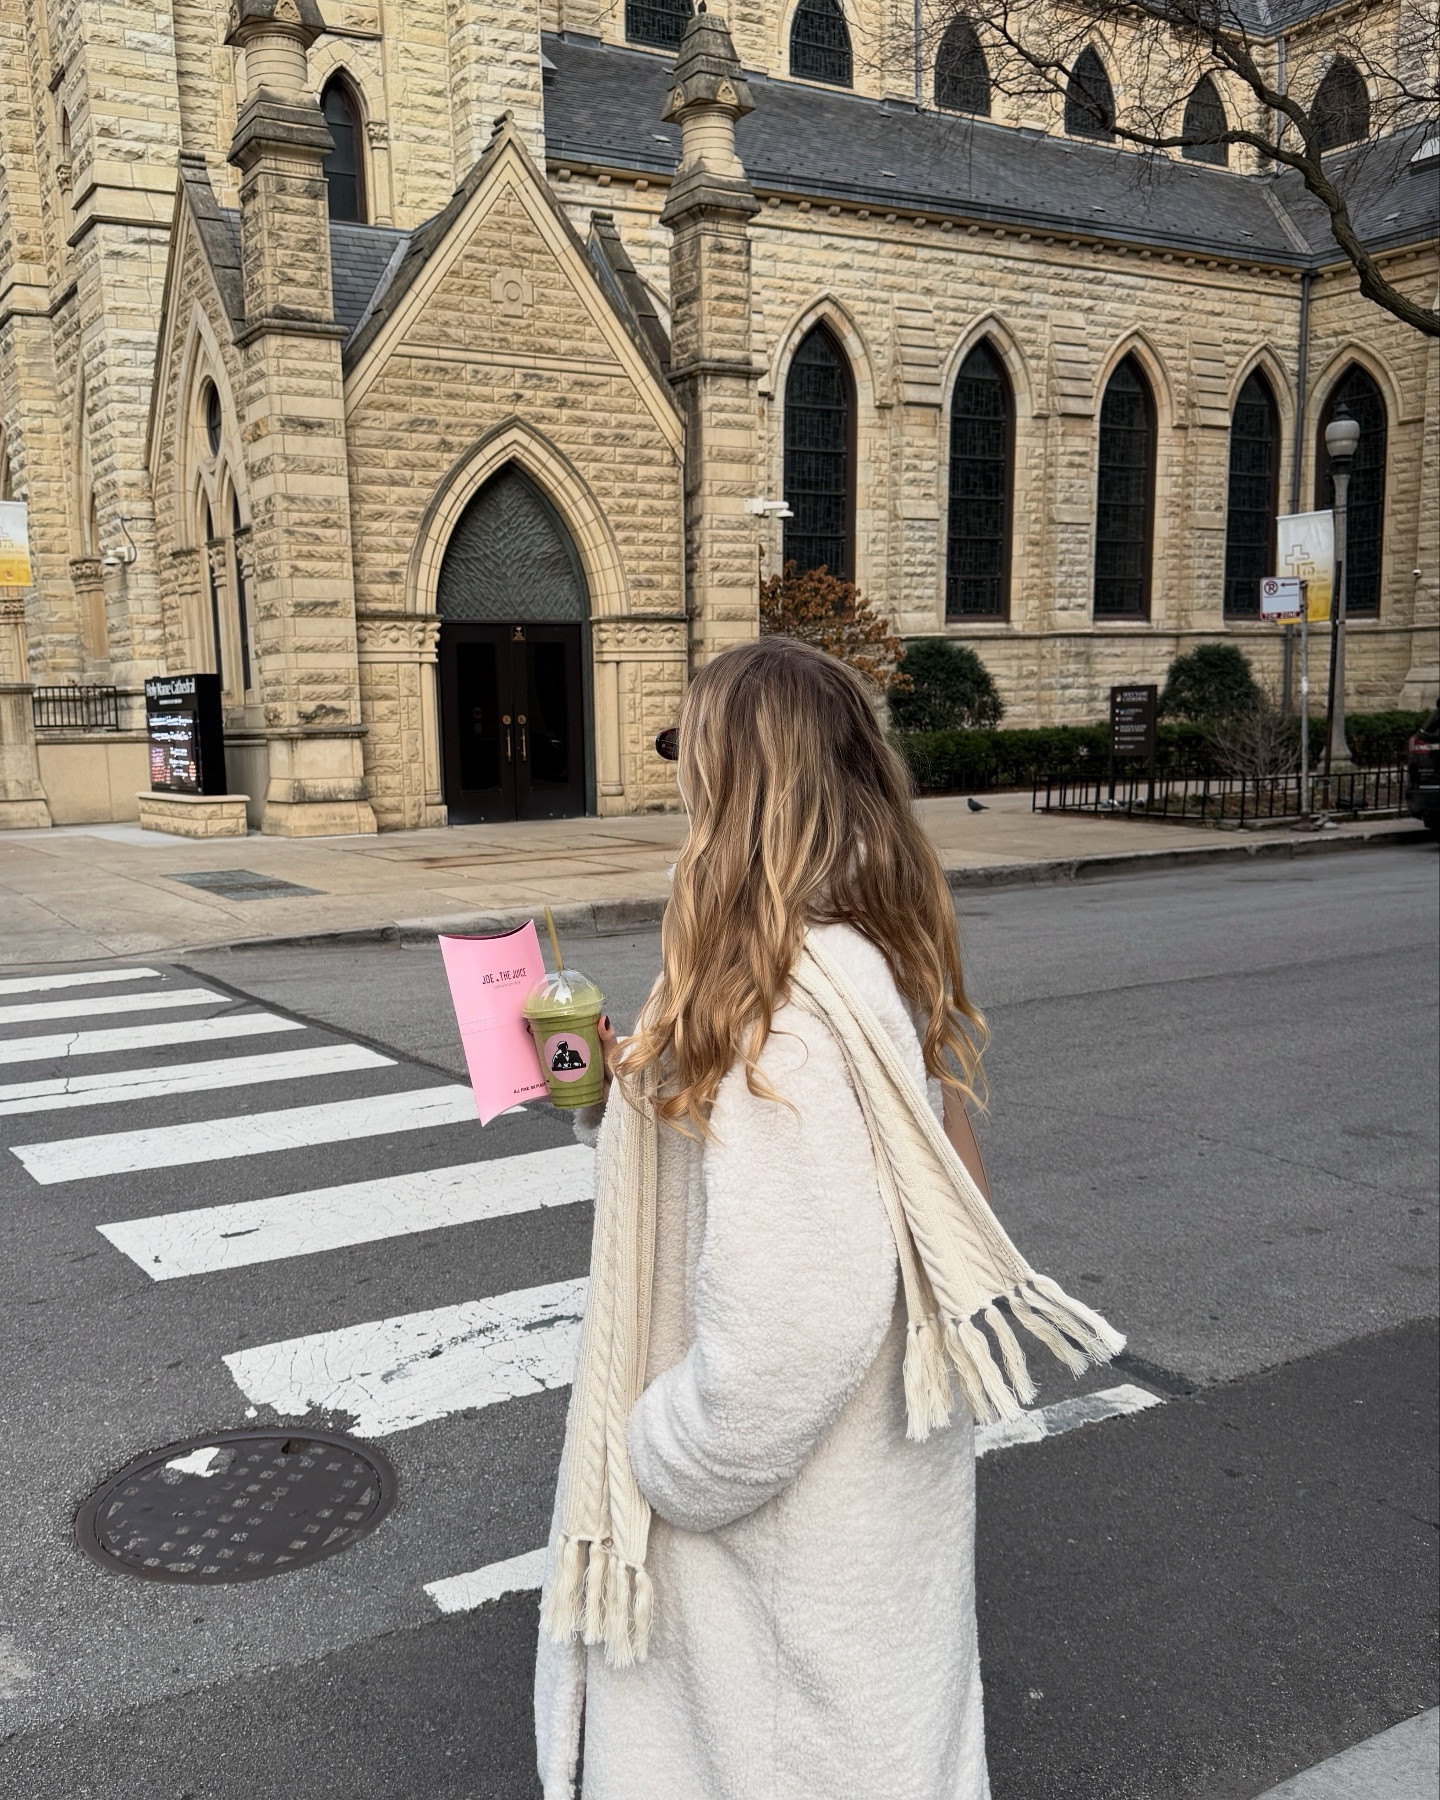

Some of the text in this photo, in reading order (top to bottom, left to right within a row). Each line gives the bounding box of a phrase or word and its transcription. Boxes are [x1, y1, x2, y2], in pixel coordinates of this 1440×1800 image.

[146, 678, 195, 700] Holy Name Cathedral
[482, 974, 494, 985] JOE
[499, 970, 512, 981] THE
[512, 967, 526, 979] JUICE
